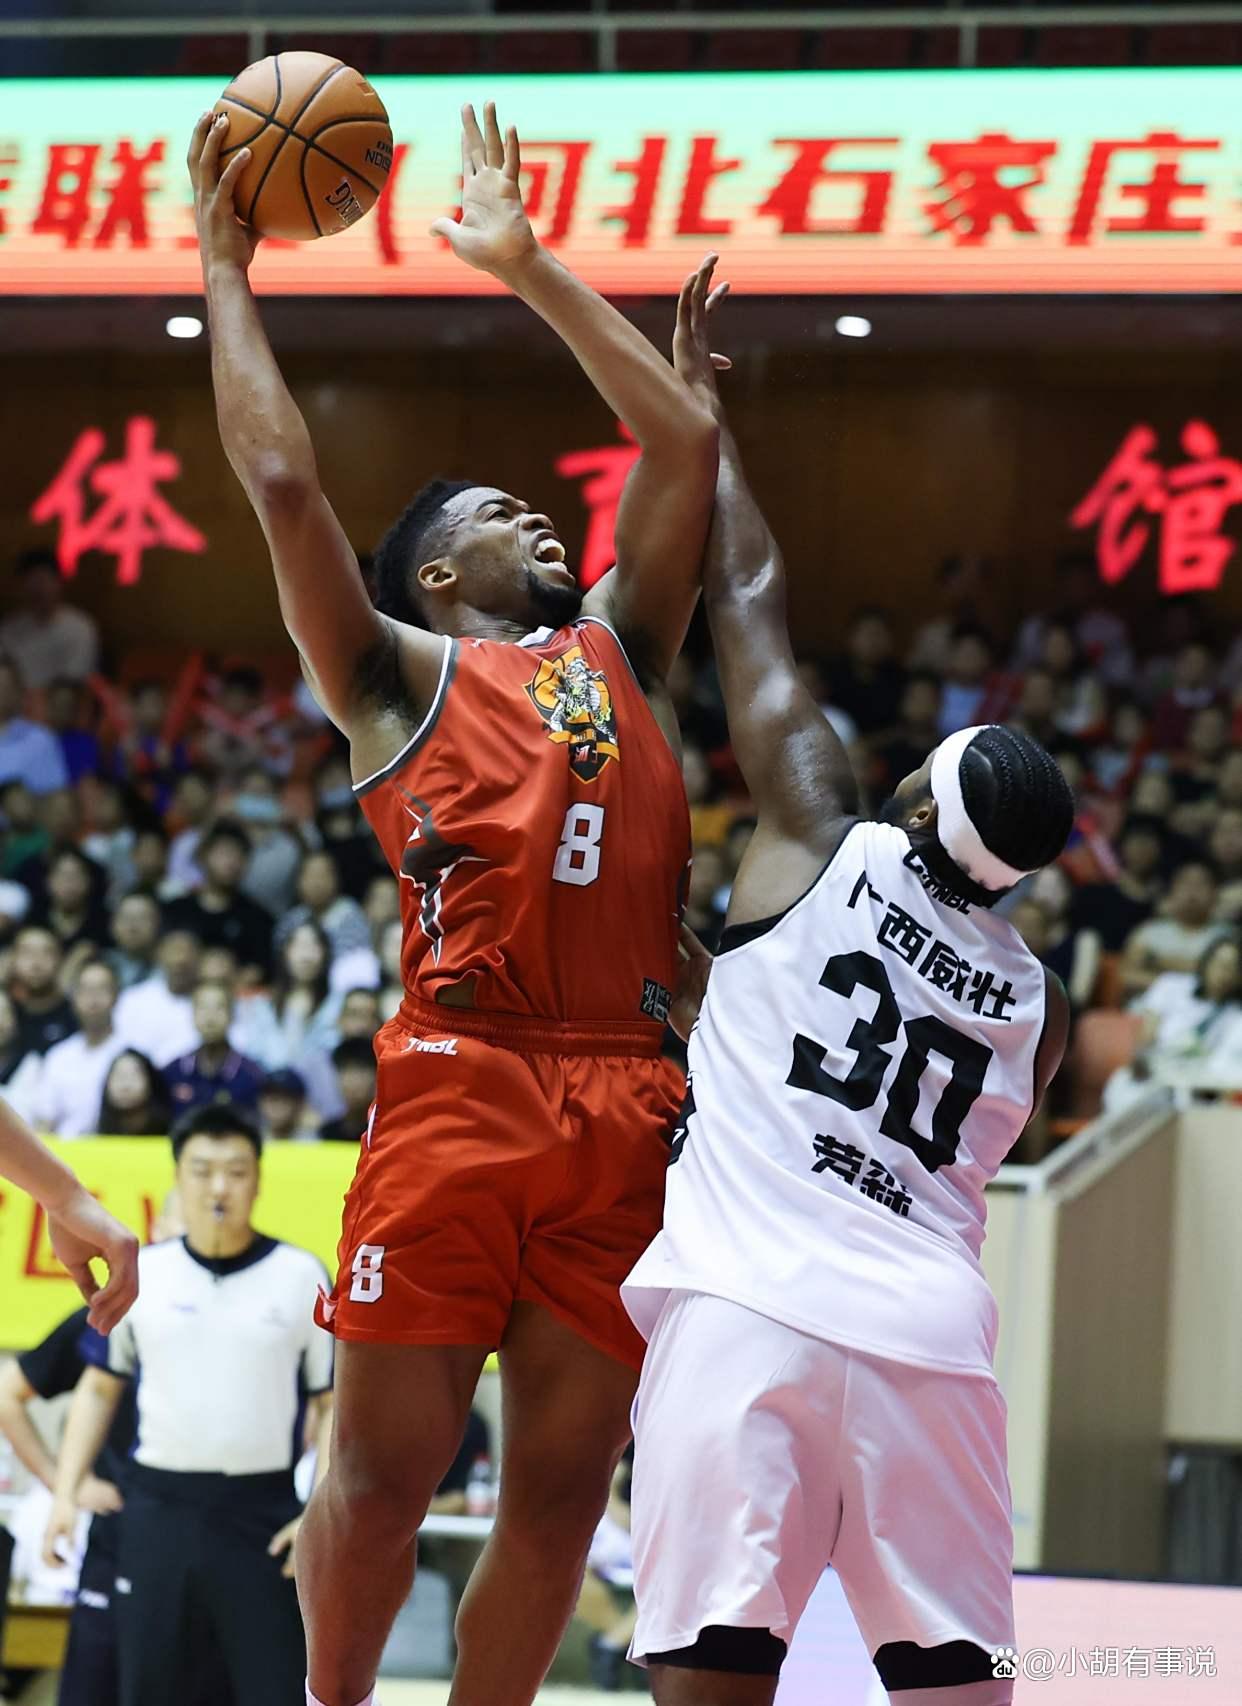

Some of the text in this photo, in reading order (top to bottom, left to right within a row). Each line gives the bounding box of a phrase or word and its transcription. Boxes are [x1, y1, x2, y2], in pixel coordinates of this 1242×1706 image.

[31, 416, 207, 585] 体
[552, 802, 605, 887] 8
[785, 950, 994, 1174] 30
[349, 1244, 385, 1303] 8
